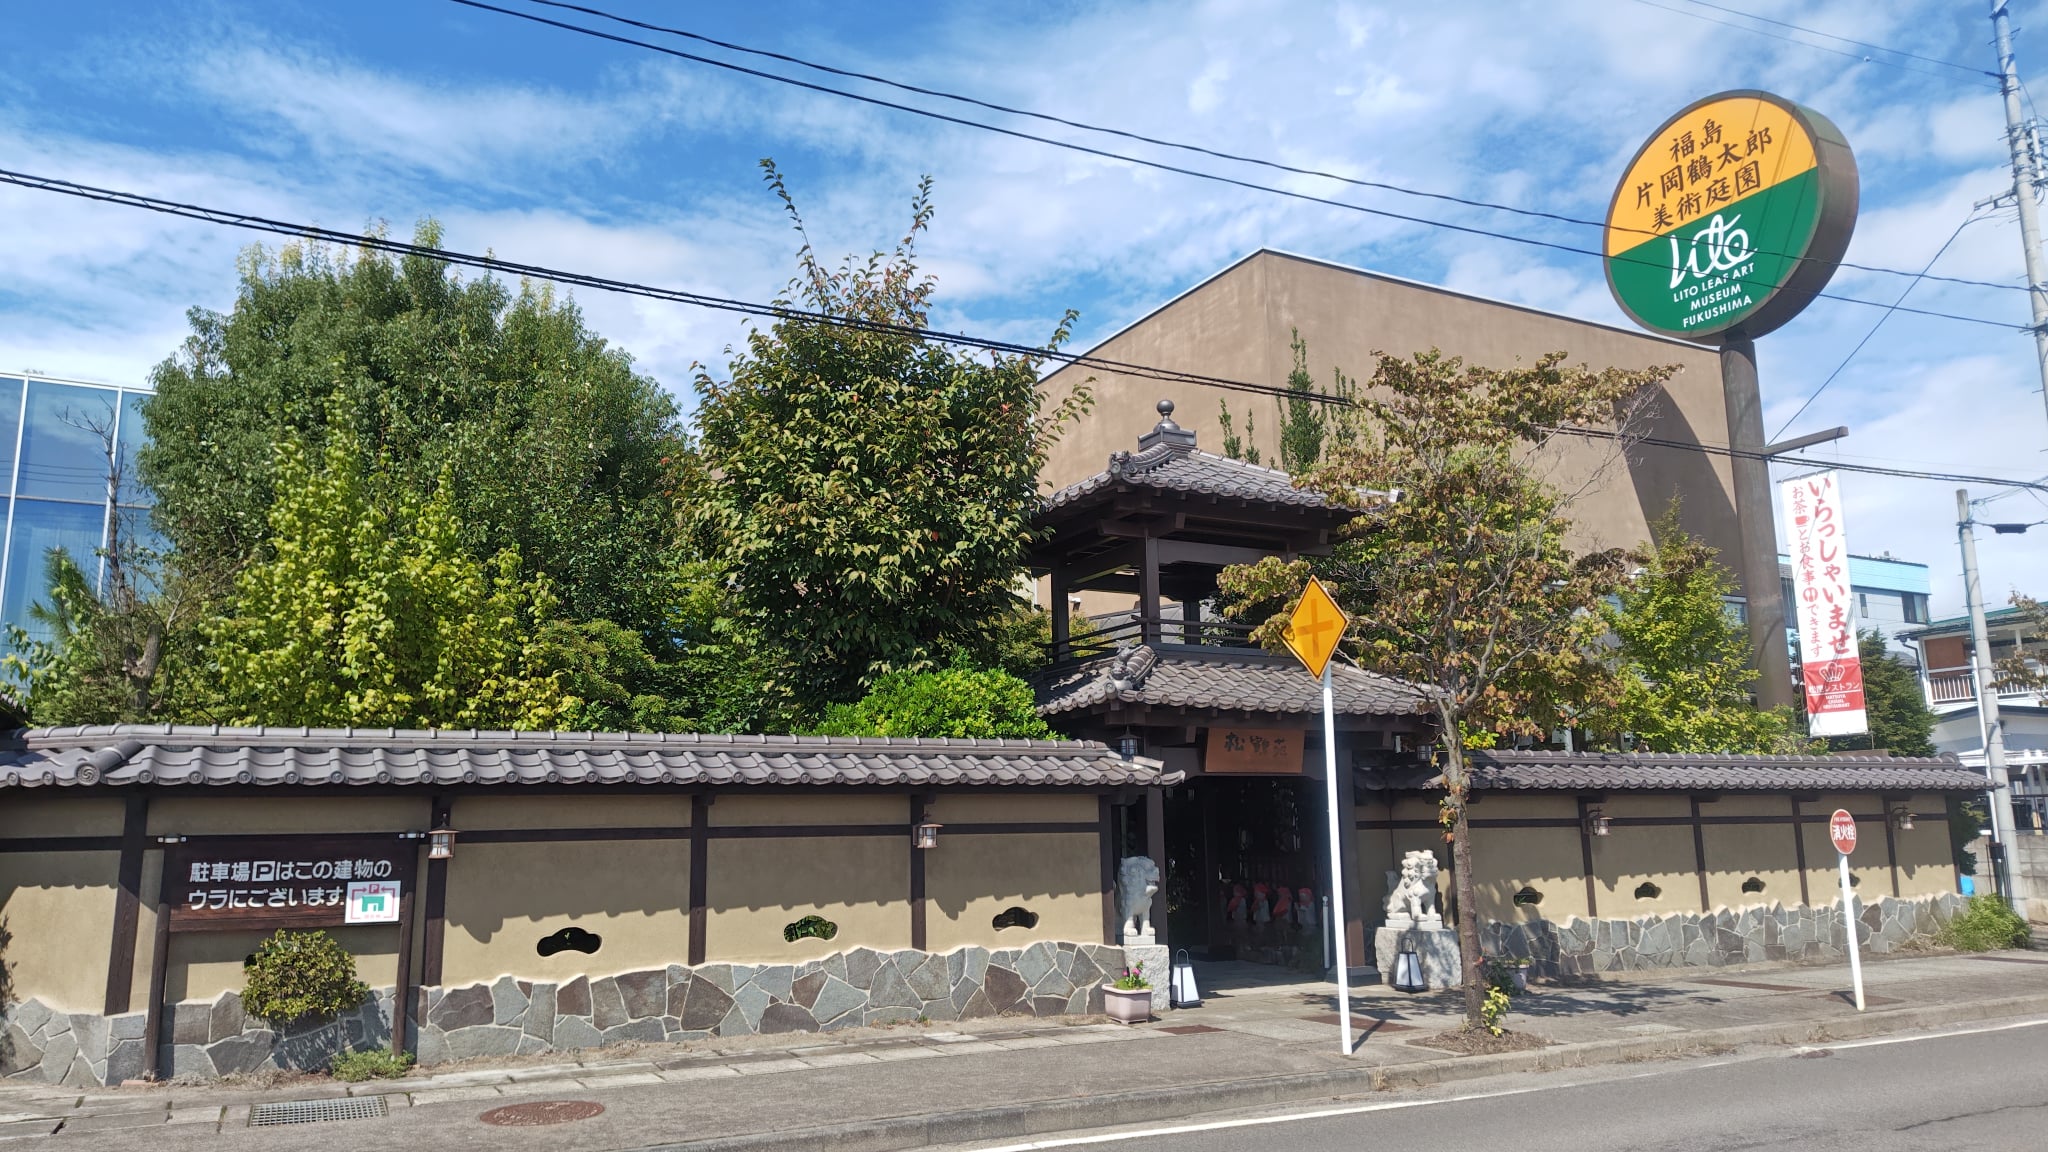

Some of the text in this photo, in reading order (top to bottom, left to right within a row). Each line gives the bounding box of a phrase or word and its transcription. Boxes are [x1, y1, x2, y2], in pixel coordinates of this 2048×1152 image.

[1670, 118, 1723, 163] 福島
[1636, 127, 1773, 210] 片岡鶴太郎
[1651, 160, 1761, 233] 美術庭園
[1673, 262, 1755, 303] LITO LEAF ART
[1690, 283, 1742, 311] MUSEUM
[1682, 295, 1753, 328] FUKUSHIMA
[1808, 477, 1851, 655] いらっしゃいませ
[1832, 824, 1855, 840] 消火栓
